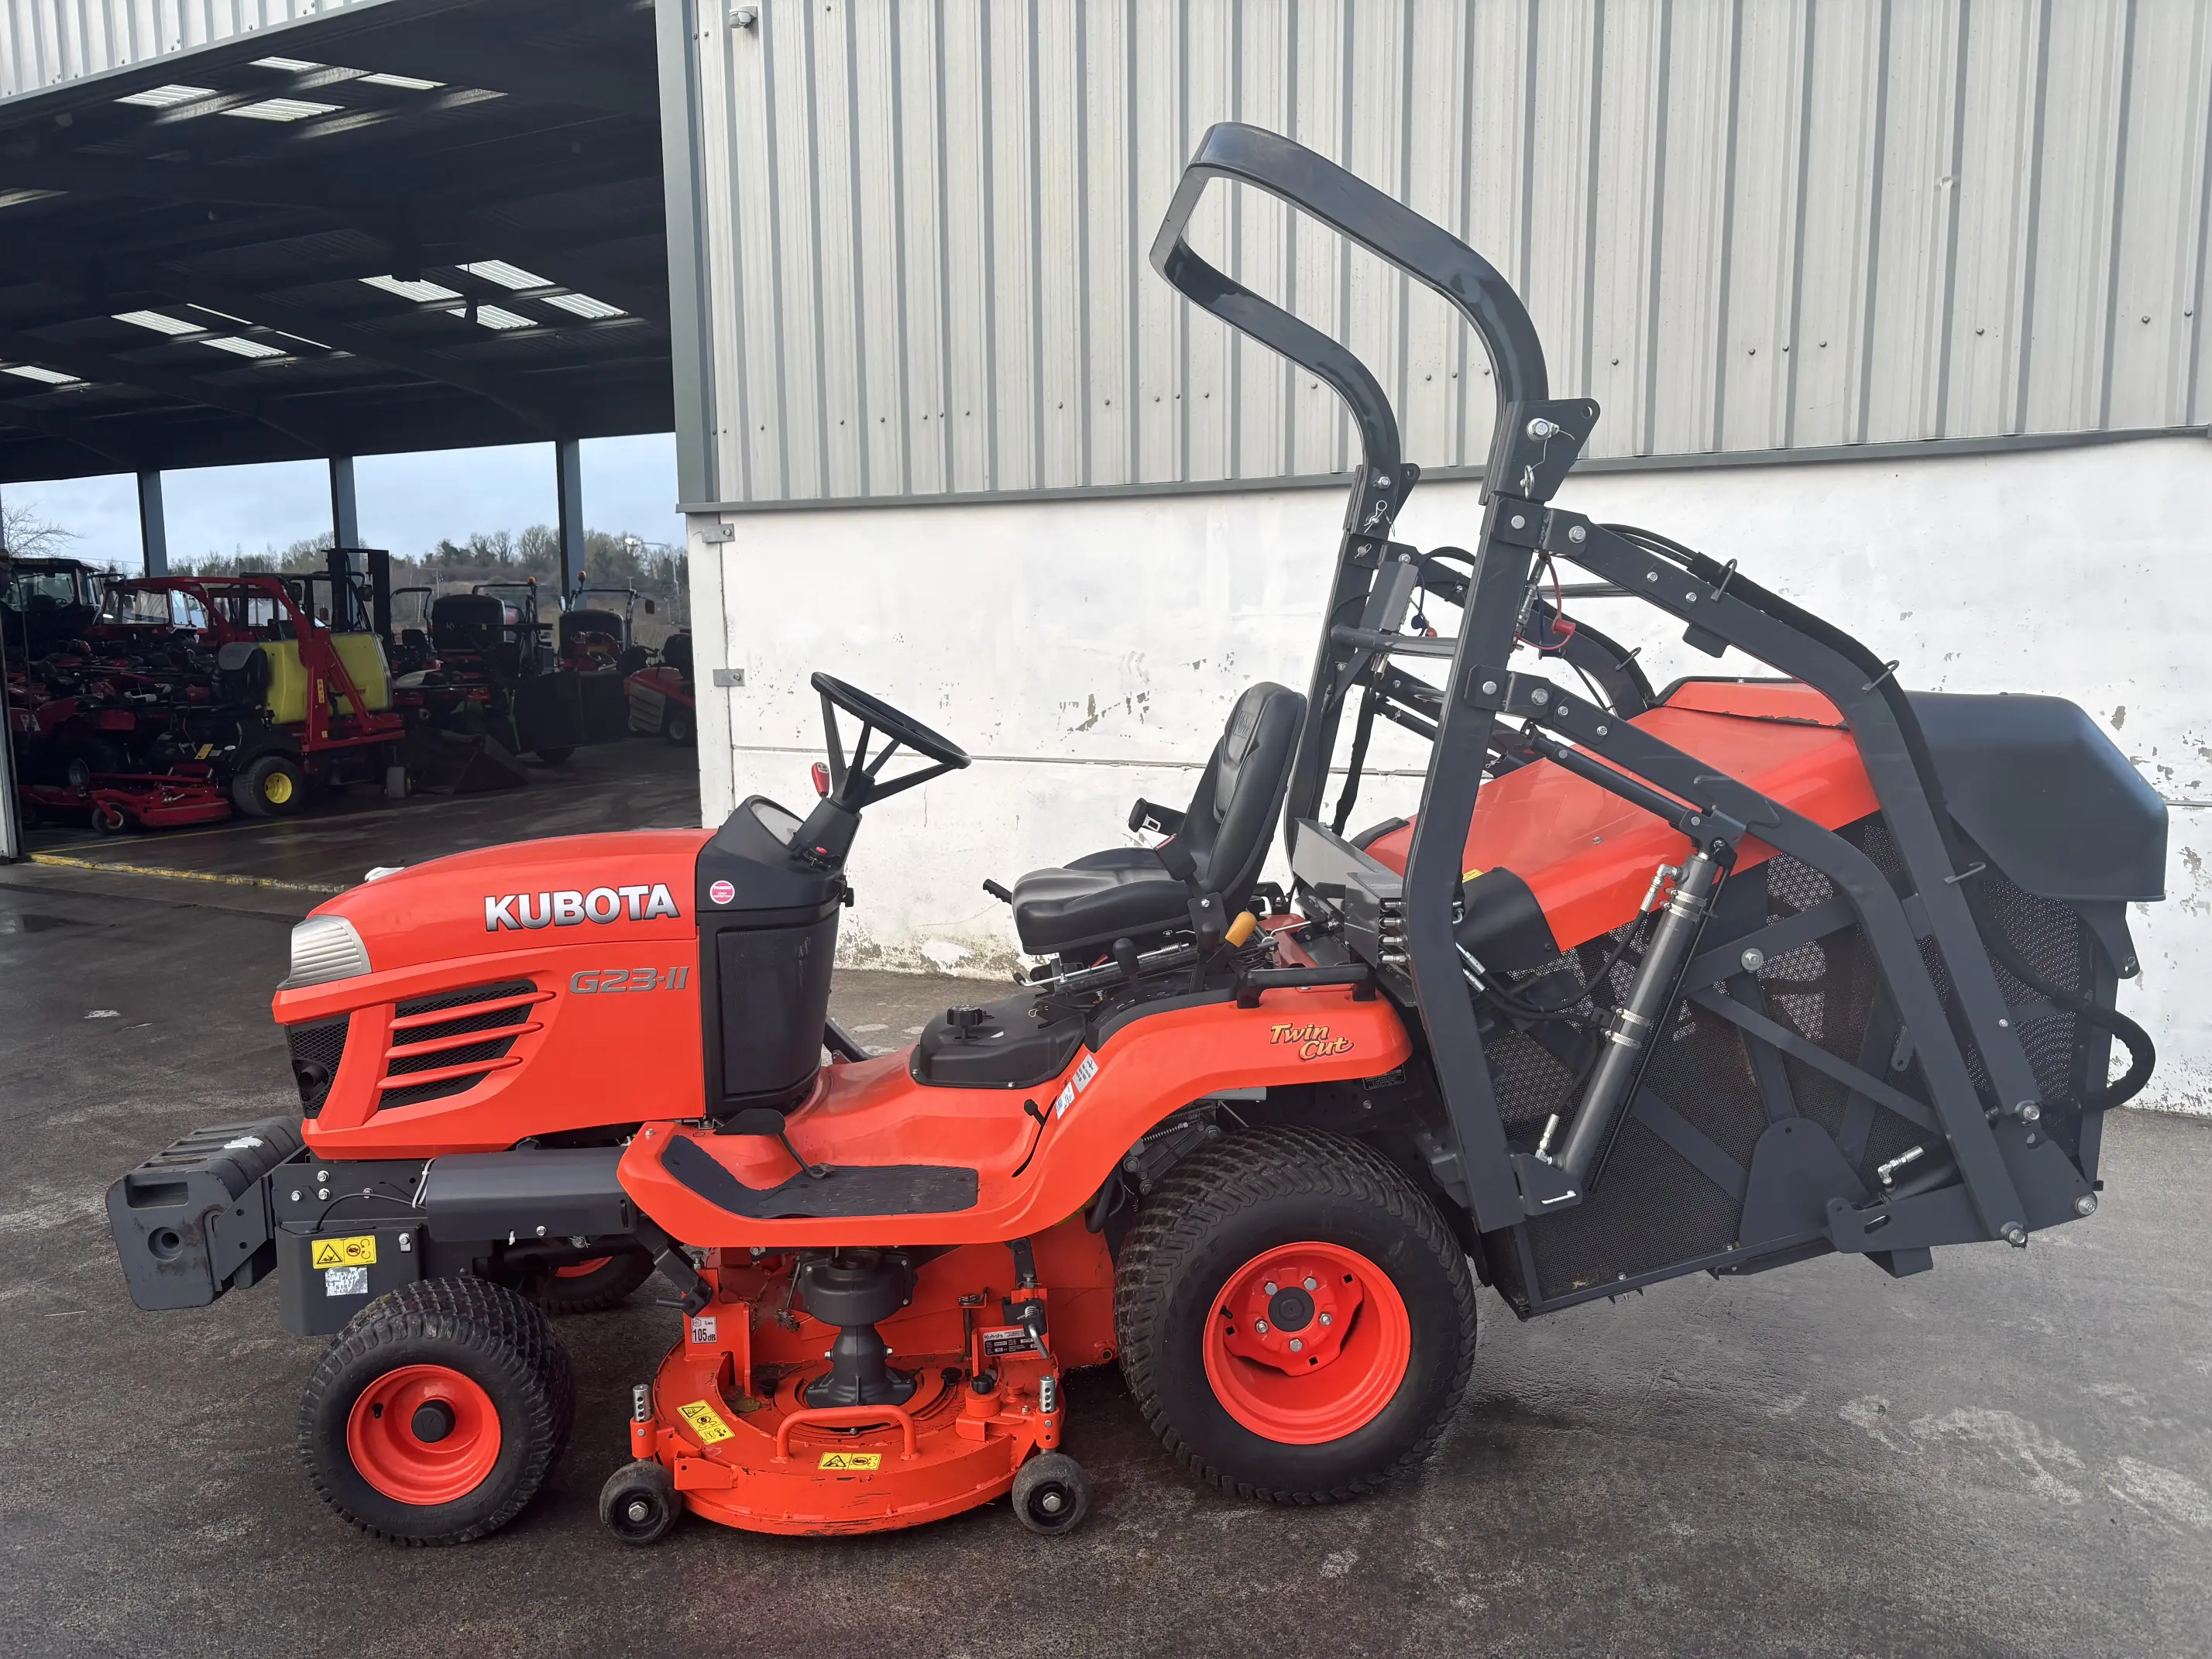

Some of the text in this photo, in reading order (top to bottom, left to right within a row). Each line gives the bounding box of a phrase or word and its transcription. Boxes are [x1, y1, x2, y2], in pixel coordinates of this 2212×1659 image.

[484, 883, 681, 932] KUBOTA
[570, 966, 689, 994] G23-II
[1270, 1023, 1330, 1044] Twin
[1299, 1036, 1354, 1062] Cut
[692, 1328, 707, 1341] 105
